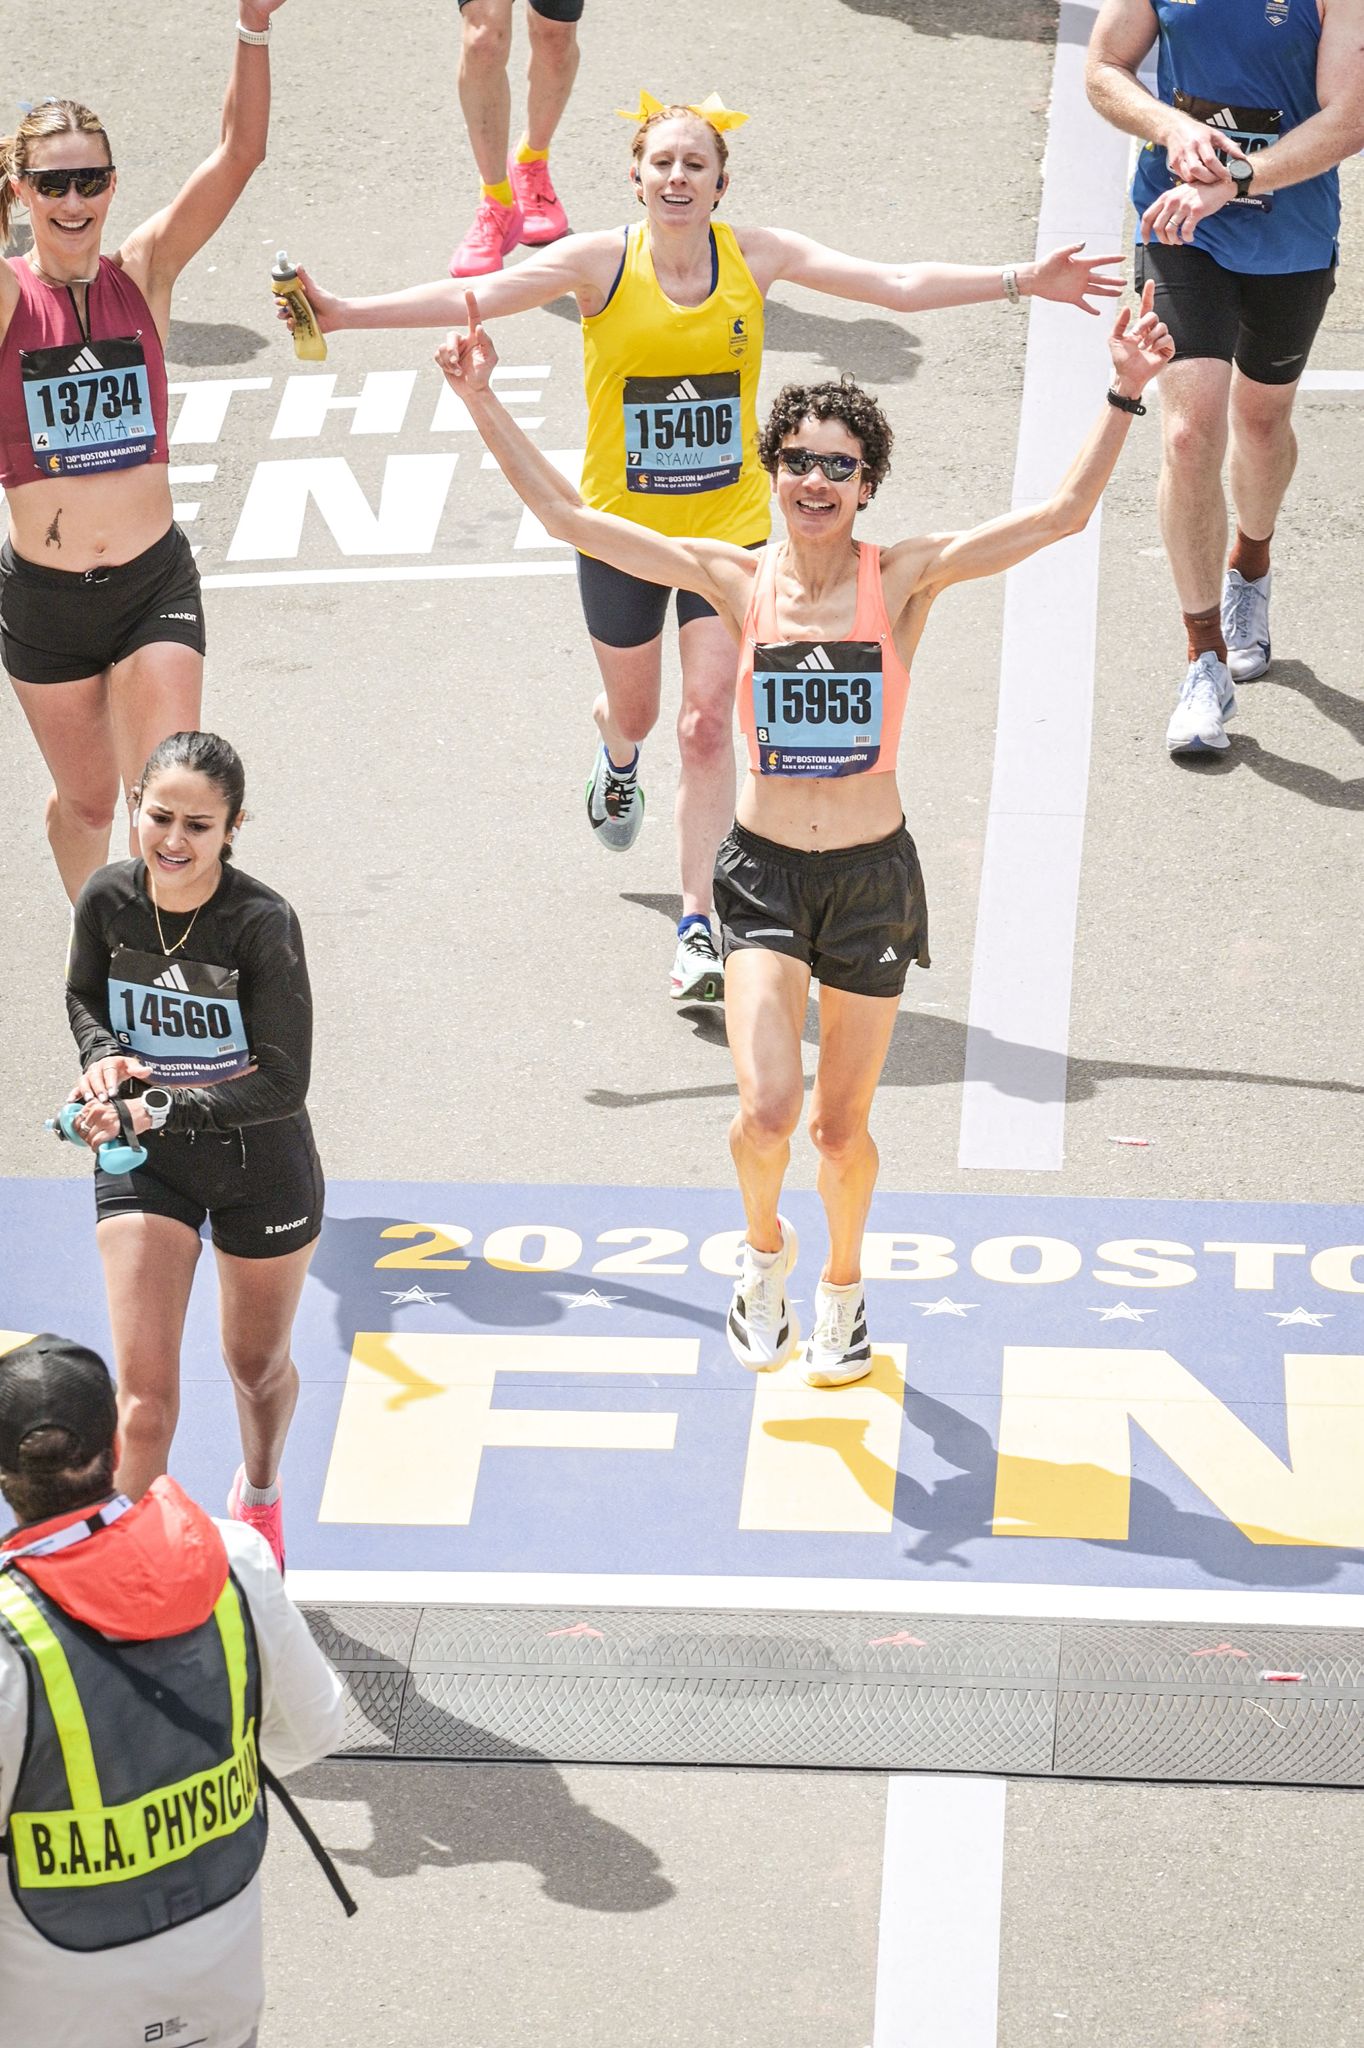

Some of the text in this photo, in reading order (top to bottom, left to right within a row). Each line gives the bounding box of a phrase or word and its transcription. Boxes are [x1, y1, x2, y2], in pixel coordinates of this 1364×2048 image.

[1232, 197, 1263, 205] ARATHON
[37, 372, 142, 427] 13734
[65, 420, 128, 443] MARIA
[635, 404, 733, 449] 15406
[37, 434, 48, 447] 4
[80, 450, 110, 462] BOSTON
[110, 444, 147, 457] MARATHON
[629, 453, 640, 465] 7
[656, 452, 704, 466] RYANN
[91, 458, 116, 466] AMERICA
[668, 474, 696, 483] BOSTON
[168, 612, 197, 622] BANDIT
[762, 678, 871, 725] 15953
[758, 728, 768, 741] 8
[796, 755, 827, 764] BOSTON
[828, 753, 868, 763] MARATHON
[120, 988, 232, 1039] 14560
[119, 1032, 130, 1043] 6
[160, 1063, 193, 1071] BOSTON
[193, 1059, 238, 1071] MARATHON
[275, 1216, 309, 1233] BANDIT
[31, 1818, 135, 1876] B.A.A.
